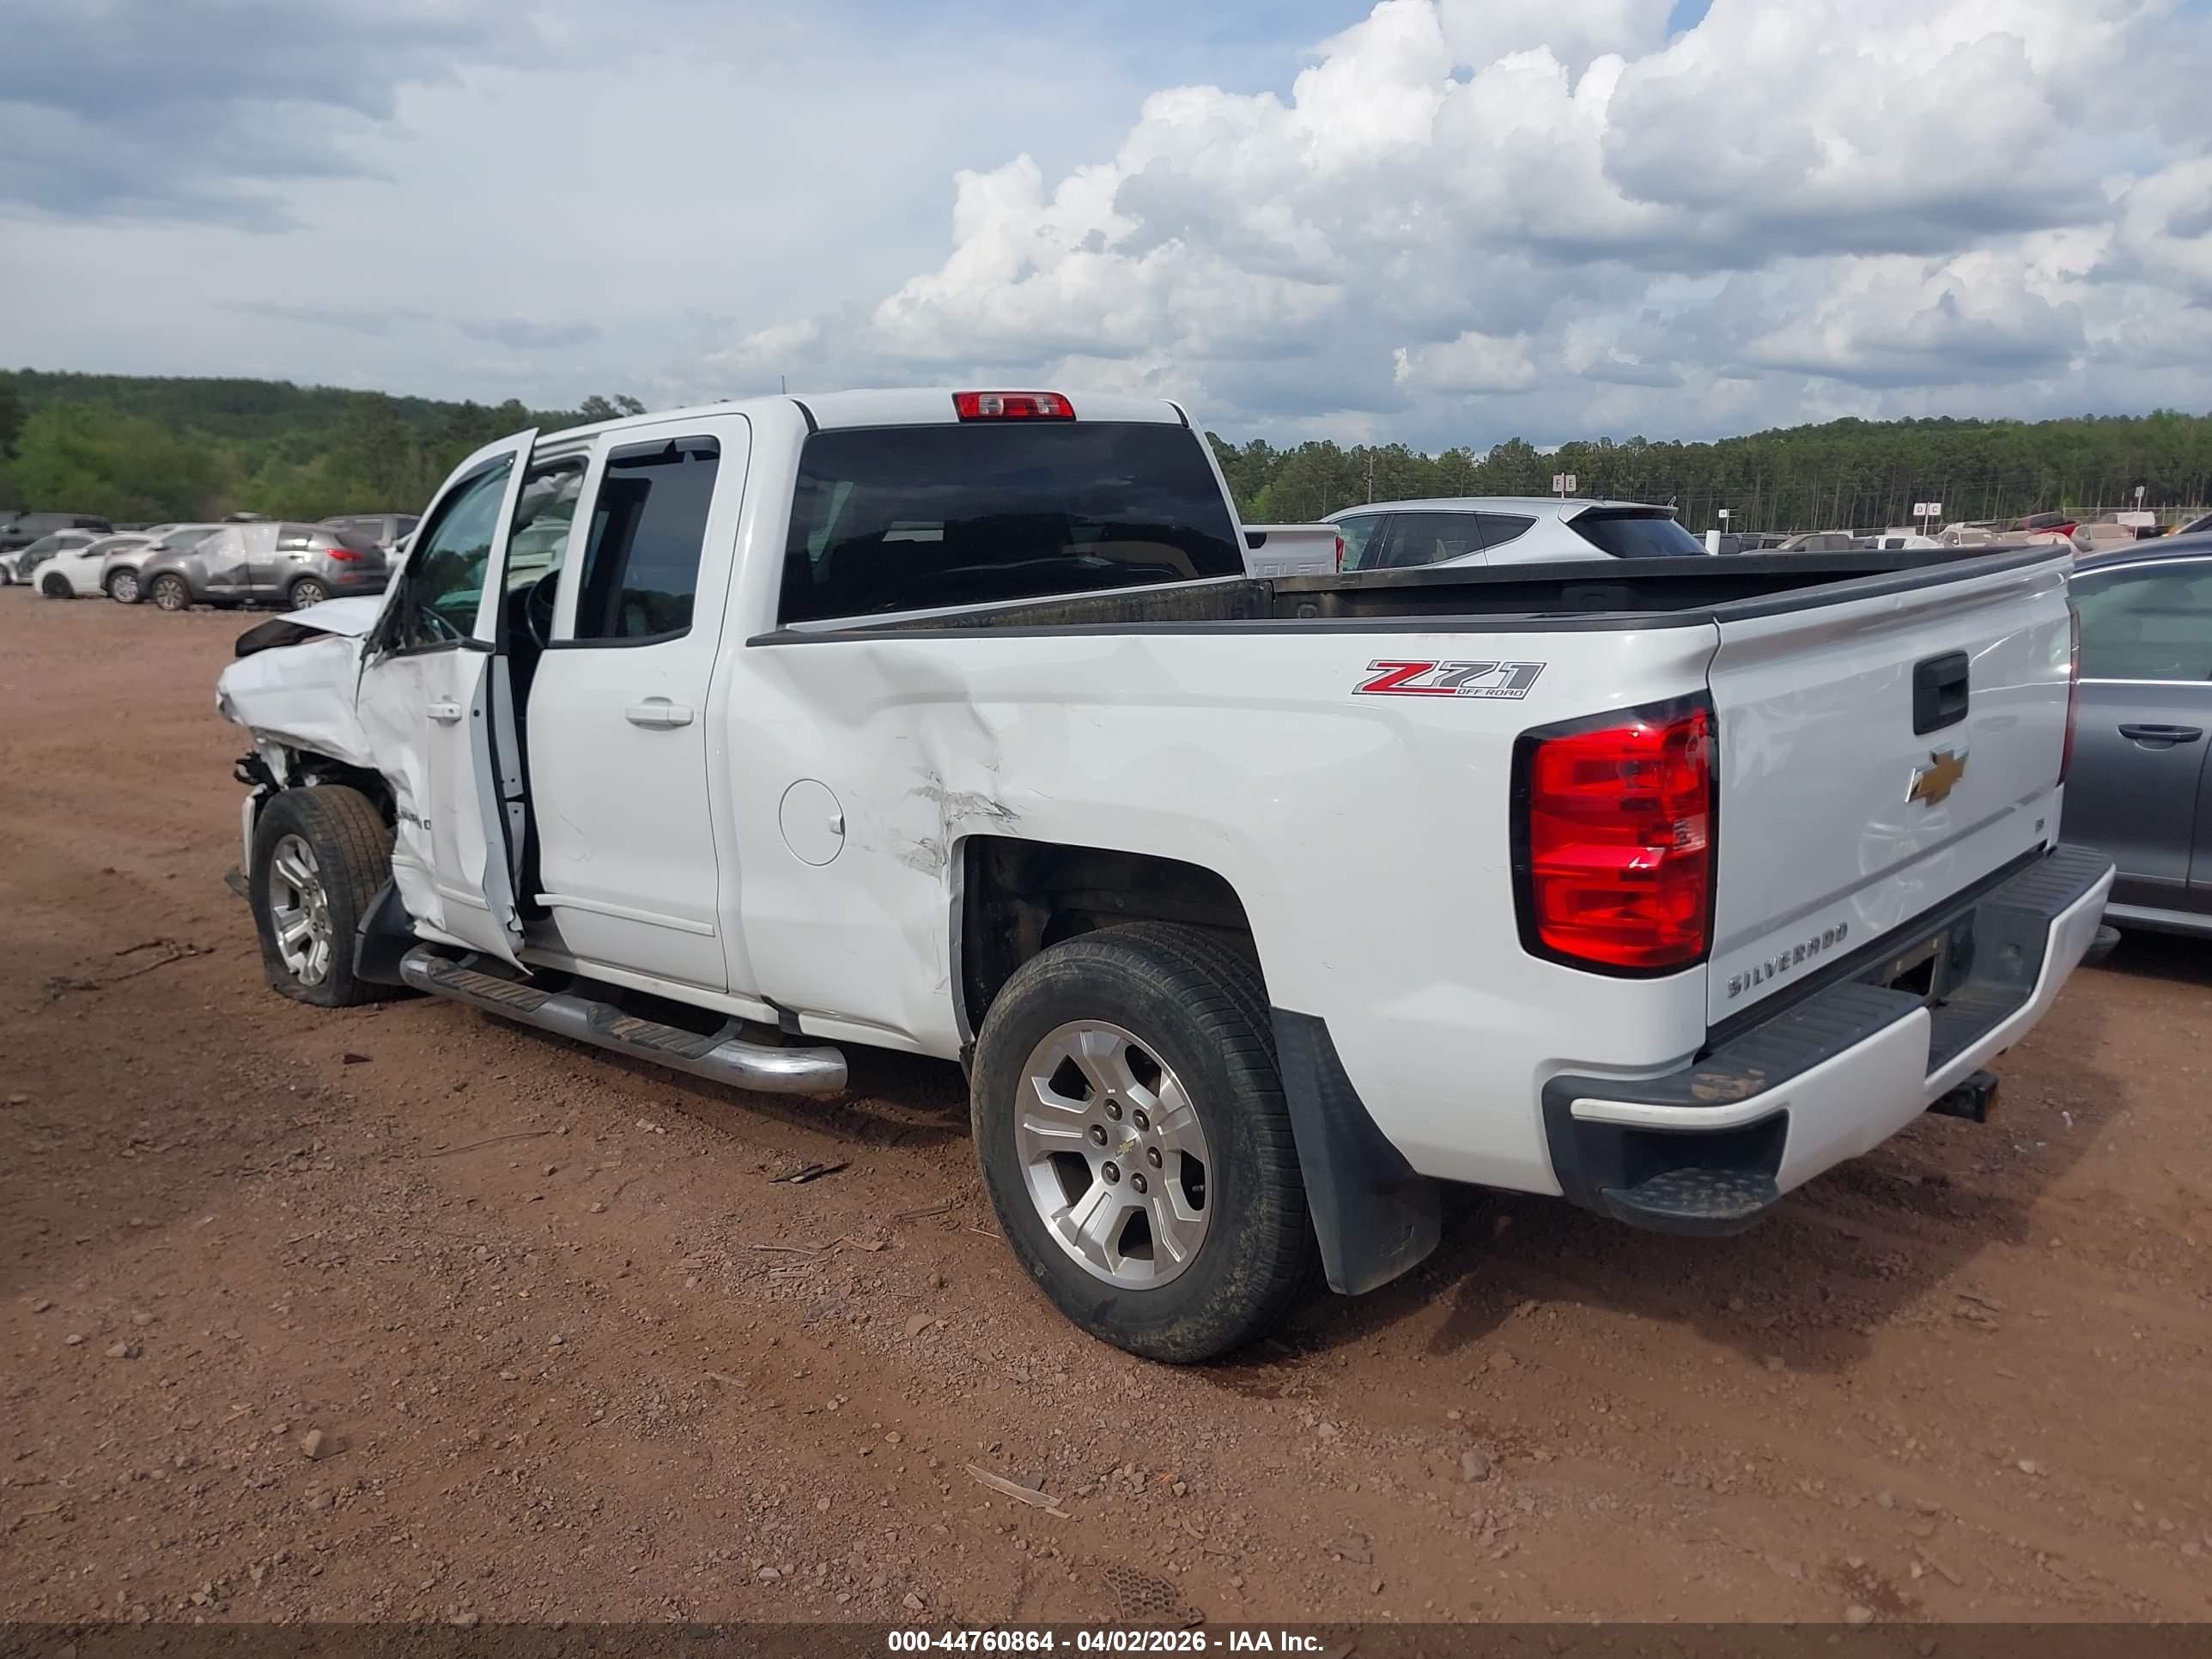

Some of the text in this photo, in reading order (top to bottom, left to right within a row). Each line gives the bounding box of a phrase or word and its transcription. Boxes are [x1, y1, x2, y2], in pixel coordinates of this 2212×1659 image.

[1556, 478, 1560, 489] F
[1569, 478, 1573, 489] E
[1352, 659, 1547, 699] Z71
[1727, 921, 1848, 999] SILVERADO
